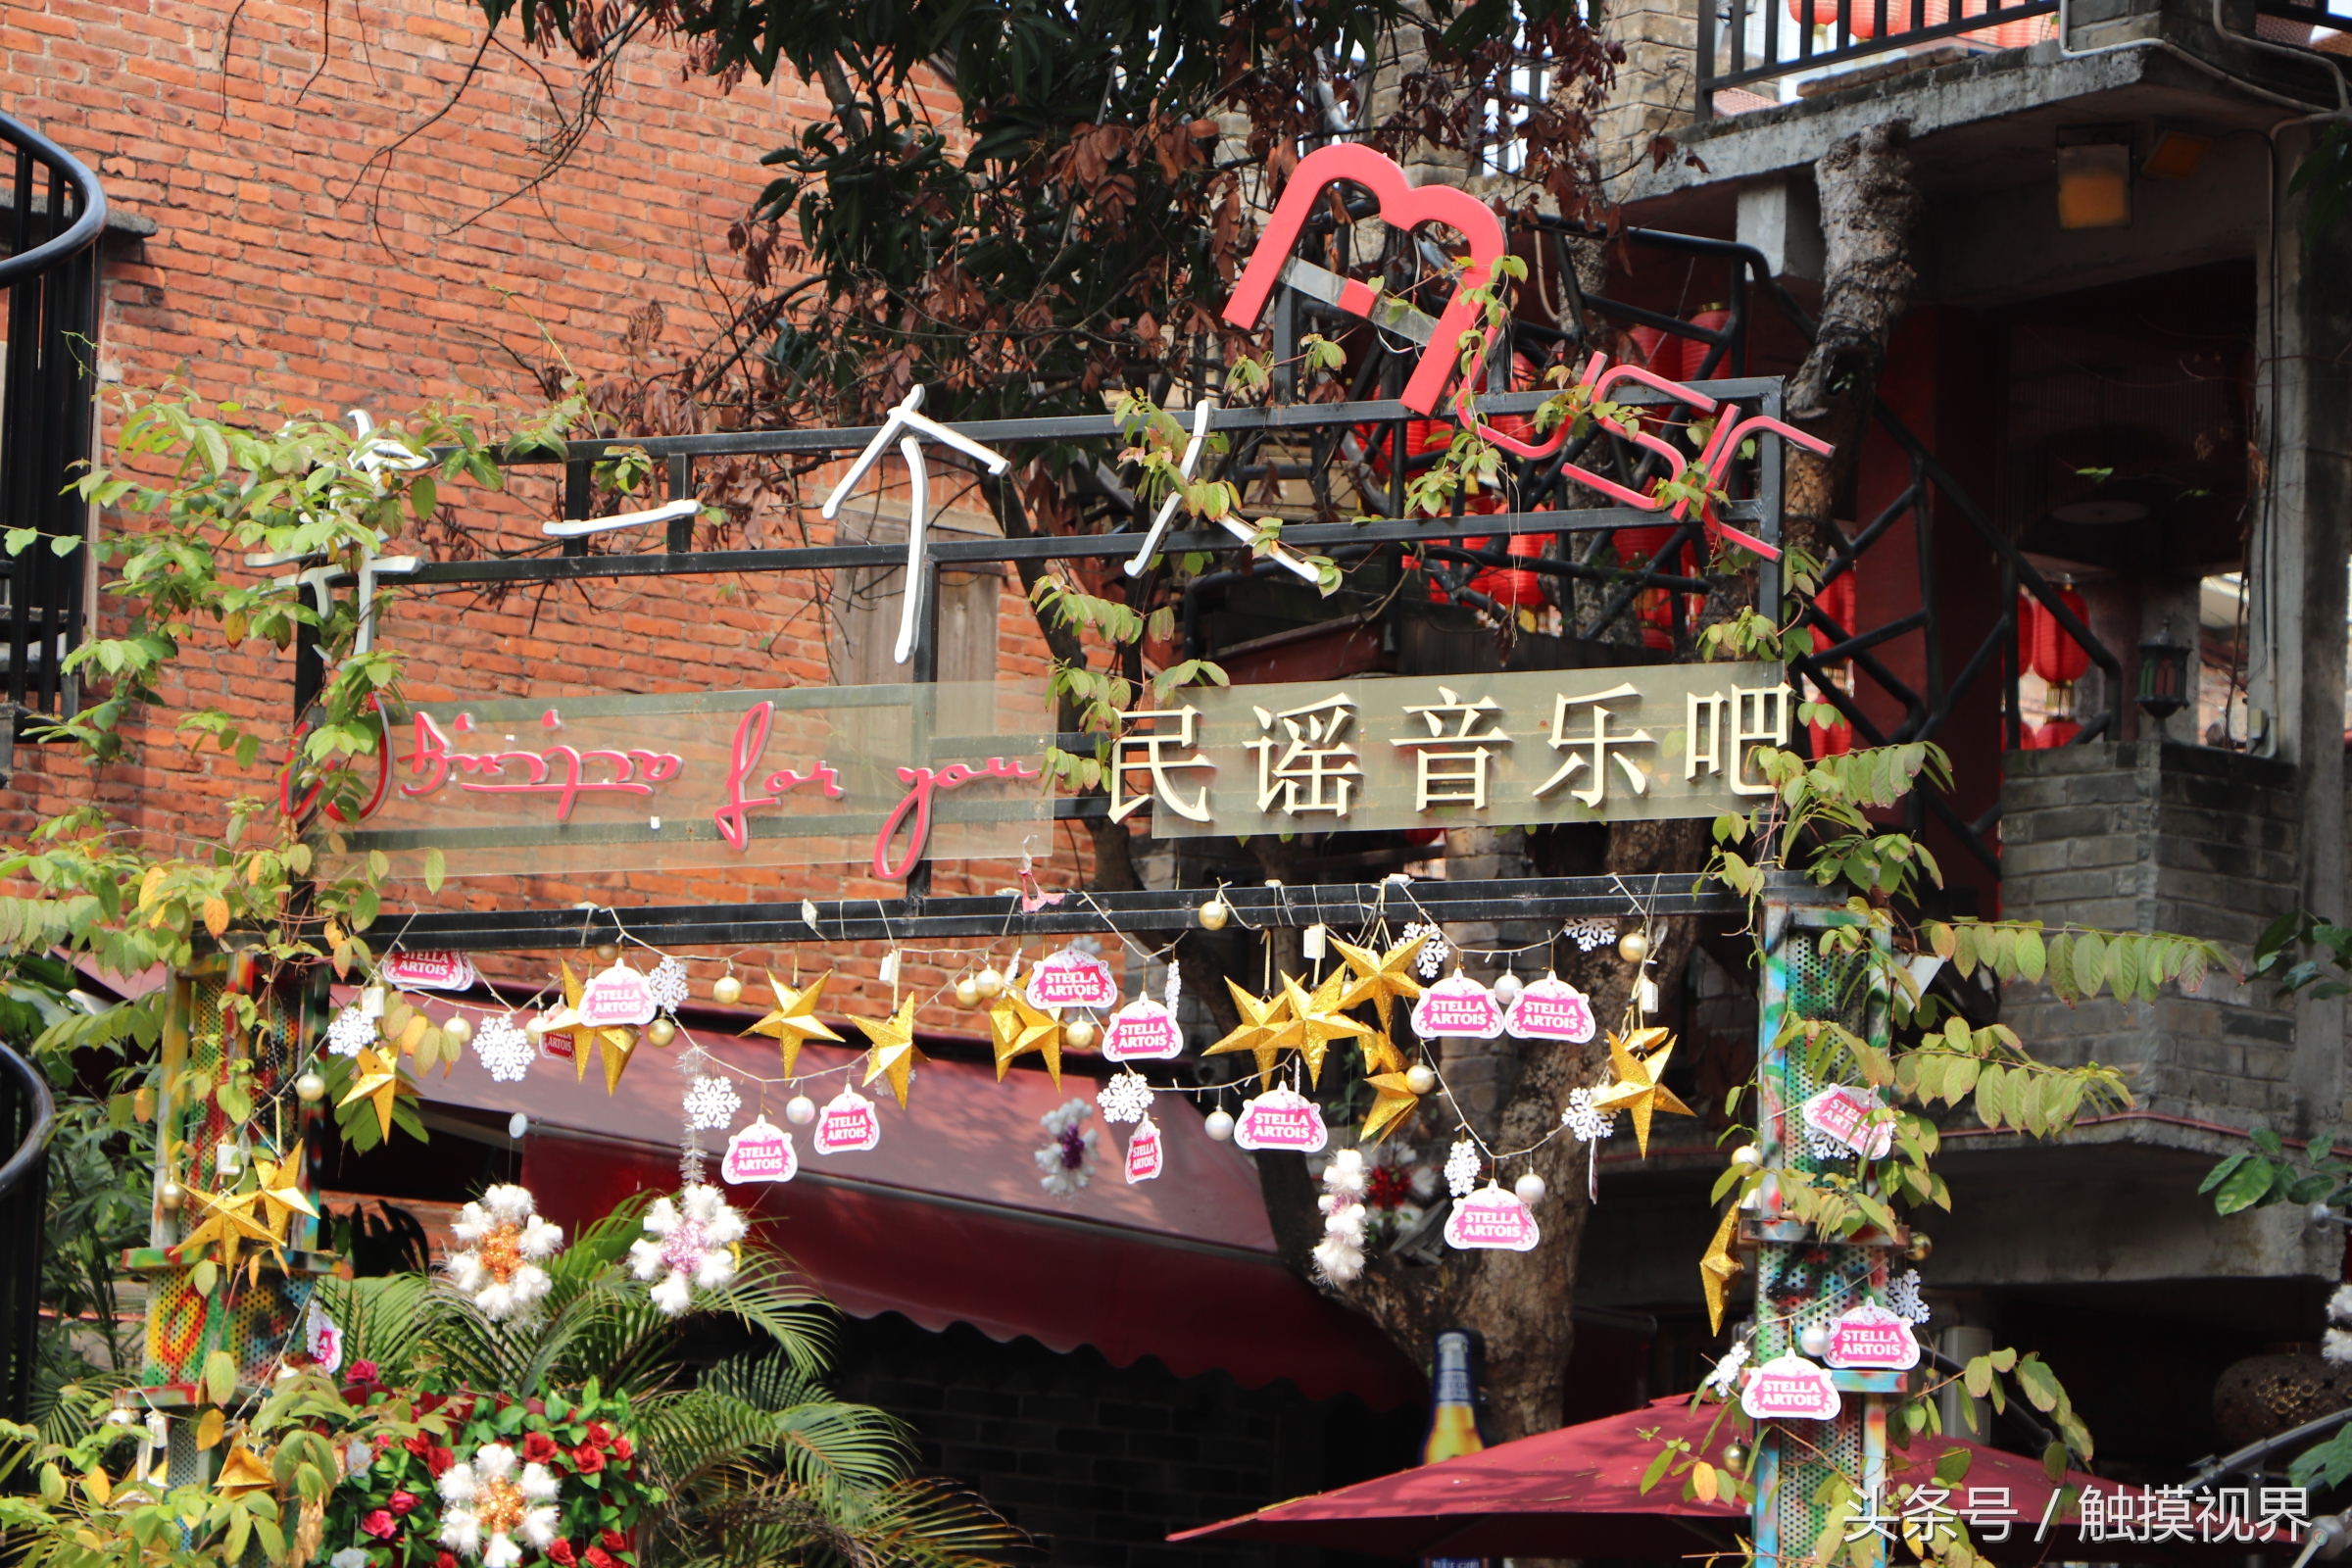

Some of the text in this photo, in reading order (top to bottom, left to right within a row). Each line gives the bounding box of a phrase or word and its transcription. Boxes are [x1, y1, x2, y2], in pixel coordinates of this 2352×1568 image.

[1106, 680, 1794, 826] 民谣音乐吧
[713, 701, 845, 852] for
[872, 757, 1042, 881] you
[398, 960, 448, 976] ARTOIS
[1045, 971, 1100, 985] STELLA
[594, 988, 641, 1002] STELLA
[1045, 983, 1101, 997] ARTOIS
[593, 1001, 642, 1014] ARTOIS
[1430, 1000, 1486, 1013] STELLA
[1523, 1001, 1579, 1017] STELLA
[1429, 1012, 1488, 1026] ARTOIS
[1522, 1013, 1579, 1030] ARTOIS
[1119, 1021, 1167, 1036] STELLA
[549, 1036, 572, 1052] ARTOIS
[1117, 1034, 1168, 1049] ARTOIS
[827, 1114, 867, 1128] STELLA
[1253, 1111, 1309, 1128] STELLA
[827, 1126, 868, 1142] ARTOIS
[1253, 1125, 1310, 1140] ARTOIS
[738, 1147, 783, 1159] STELLA
[737, 1157, 784, 1172] ARTOIS
[1463, 1211, 1521, 1226] STELLA
[1463, 1224, 1522, 1239] ARTOIS
[1841, 1330, 1901, 1344] STELLA
[1840, 1343, 1901, 1356] ARTOIS
[1761, 1379, 1821, 1394] STELLA
[1761, 1393, 1823, 1407] ARTOIS
